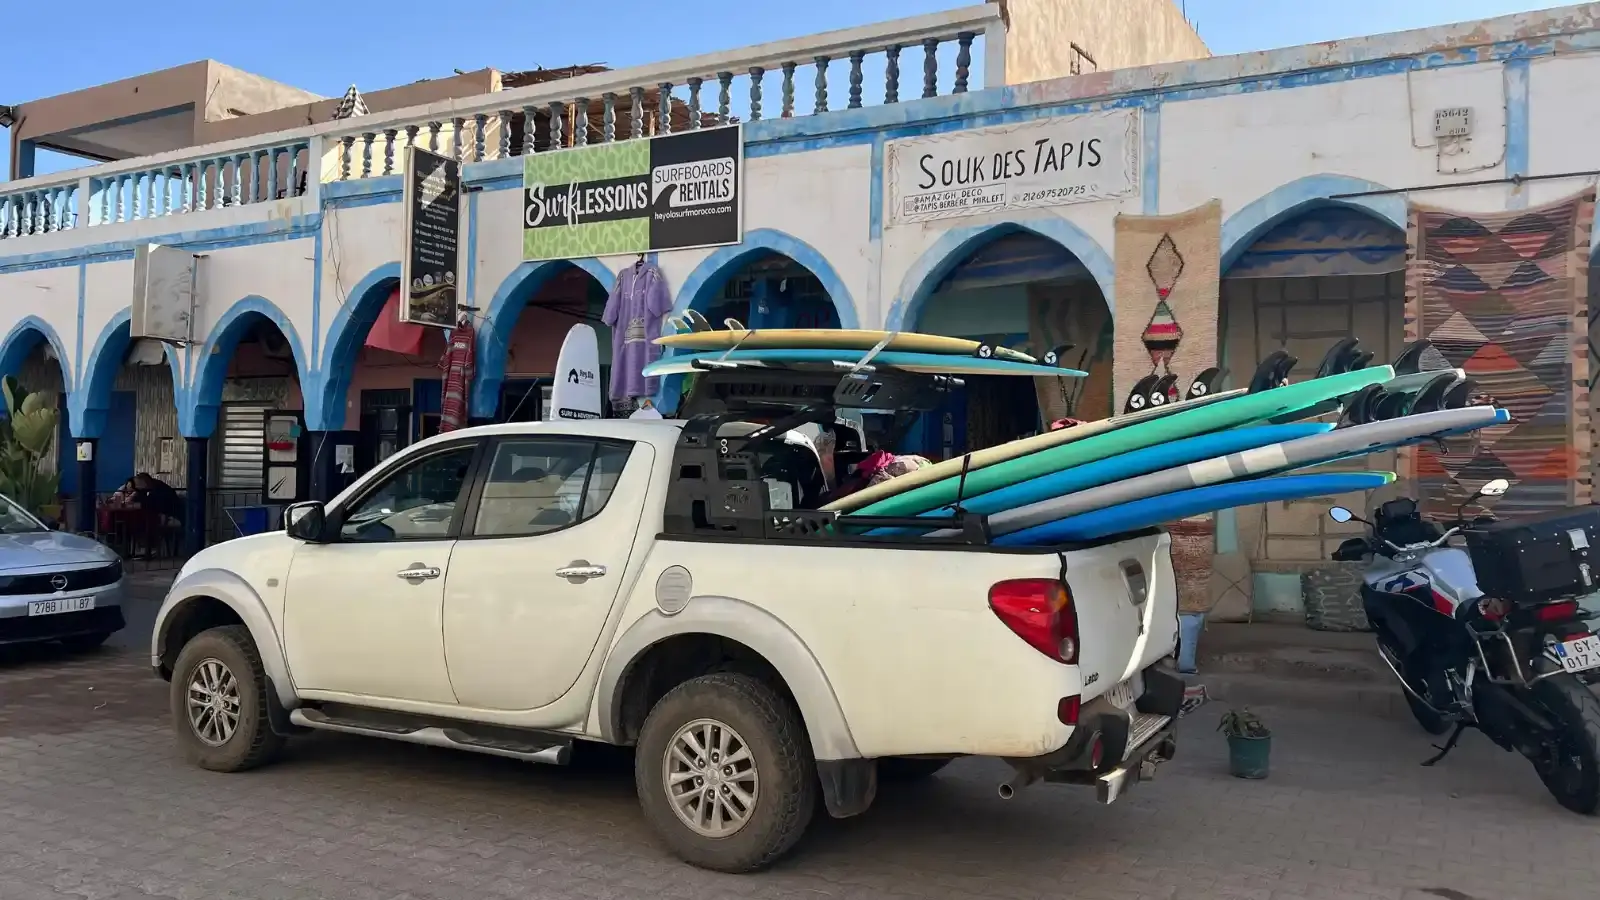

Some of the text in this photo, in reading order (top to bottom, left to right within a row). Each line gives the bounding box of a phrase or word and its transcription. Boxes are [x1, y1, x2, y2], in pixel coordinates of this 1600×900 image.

[655, 160, 733, 184] SURFBOARDS
[992, 149, 1026, 181] DES
[679, 178, 730, 202] RENTALS
[35, 601, 56, 614] 2788
